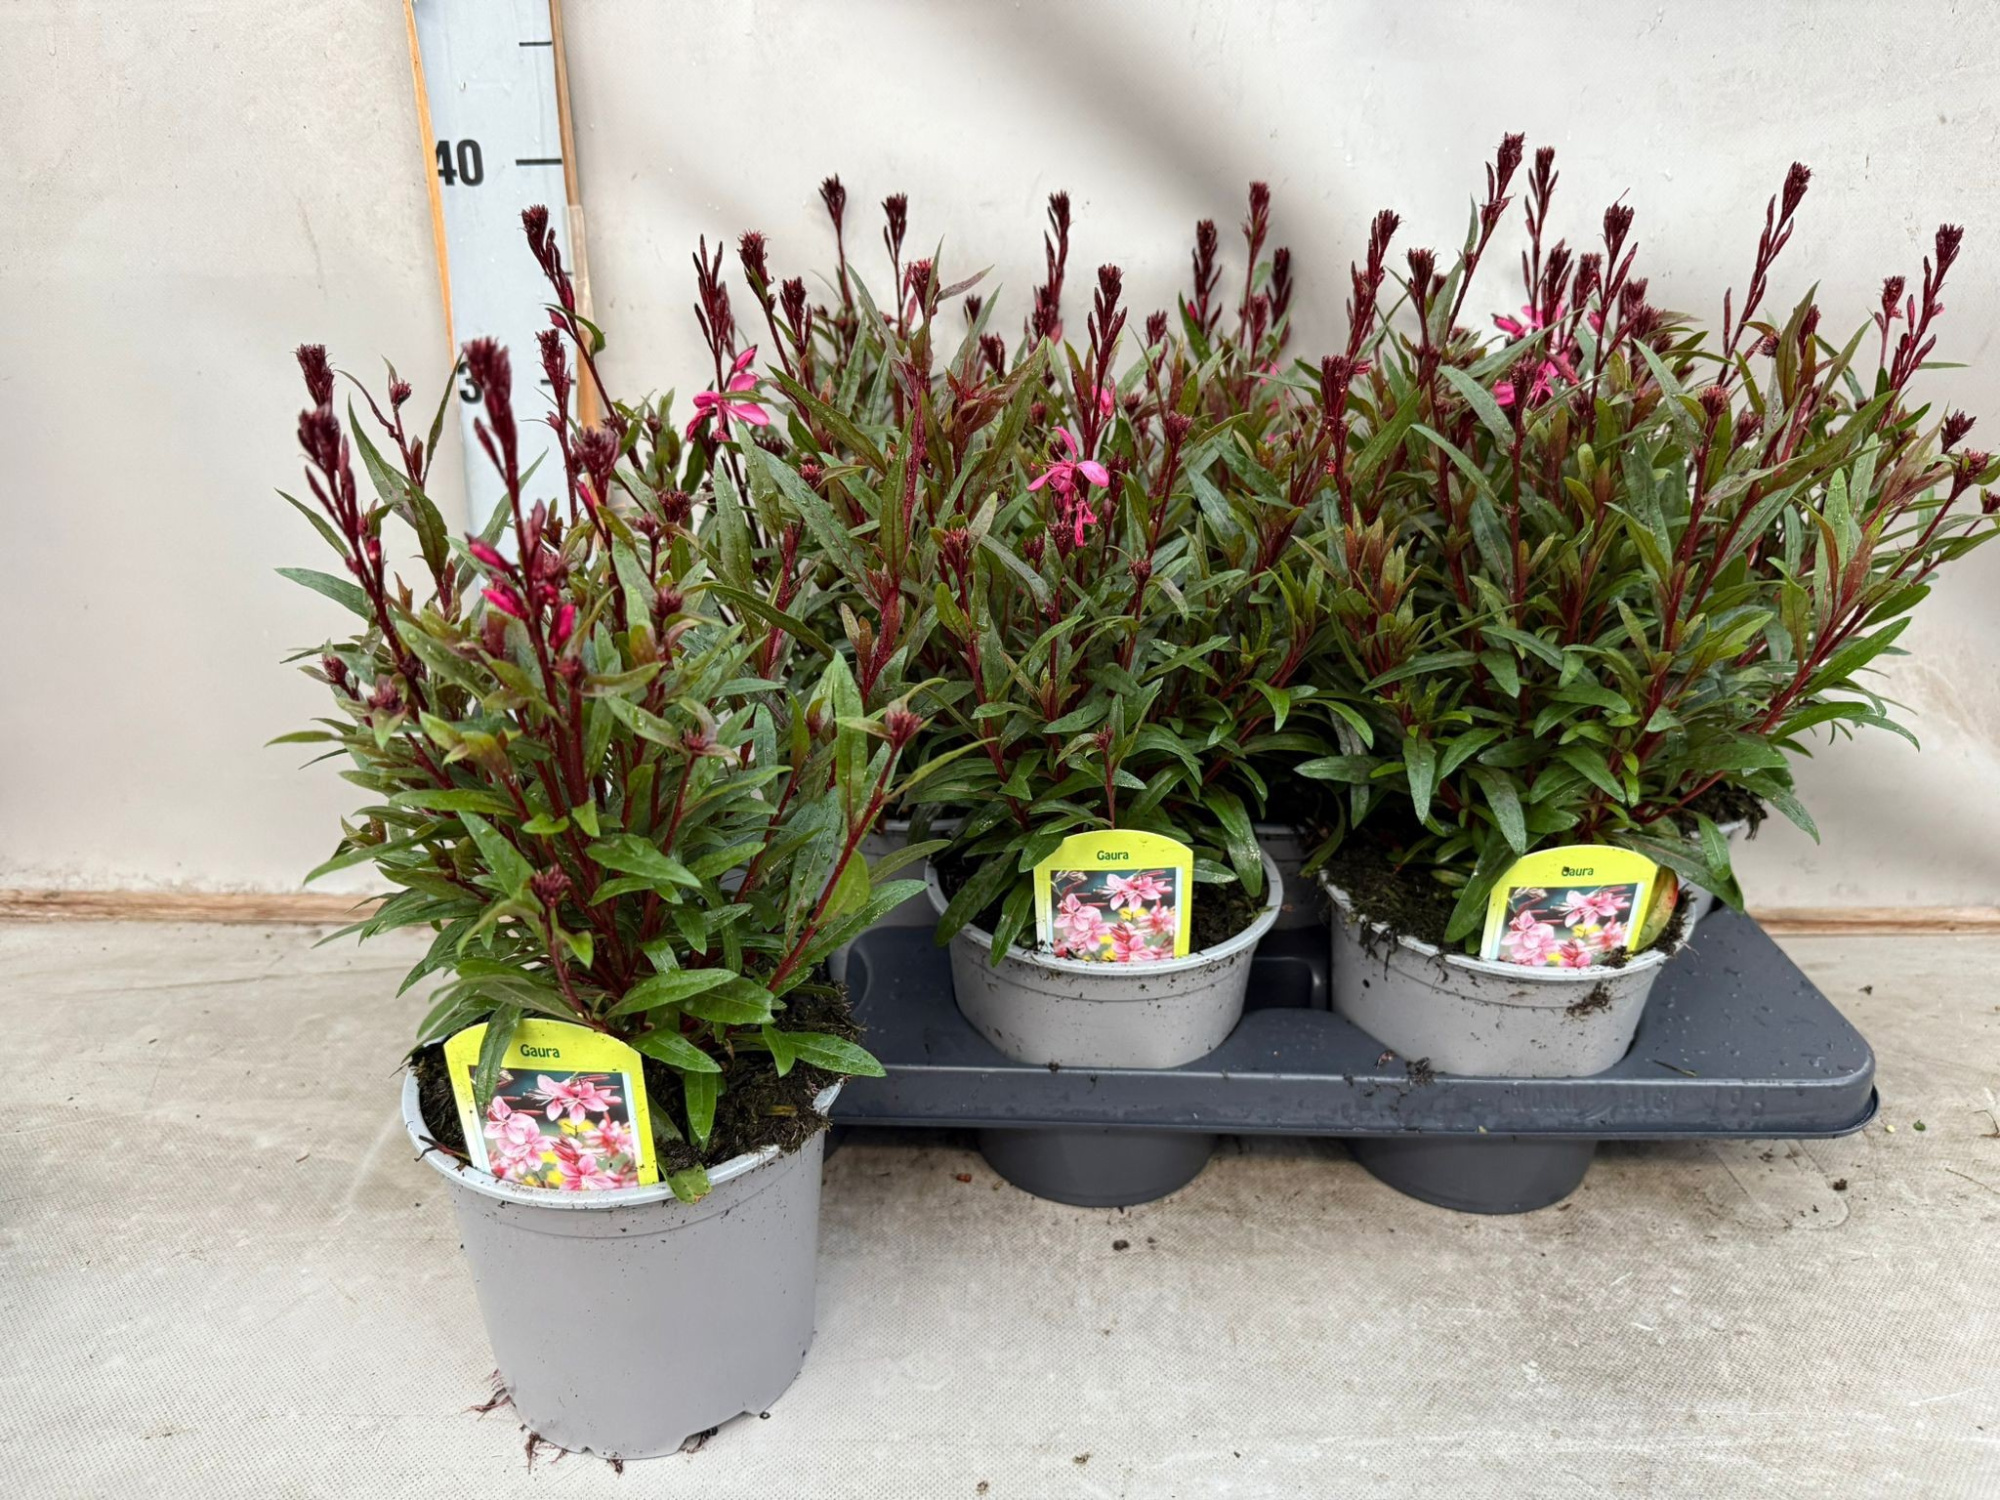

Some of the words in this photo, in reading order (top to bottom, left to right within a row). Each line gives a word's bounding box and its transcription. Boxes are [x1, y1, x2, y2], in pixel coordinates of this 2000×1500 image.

[435, 139, 484, 187] 40
[457, 362, 484, 405] 3
[1096, 849, 1129, 861] Gaura
[520, 1043, 561, 1058] Gaura
